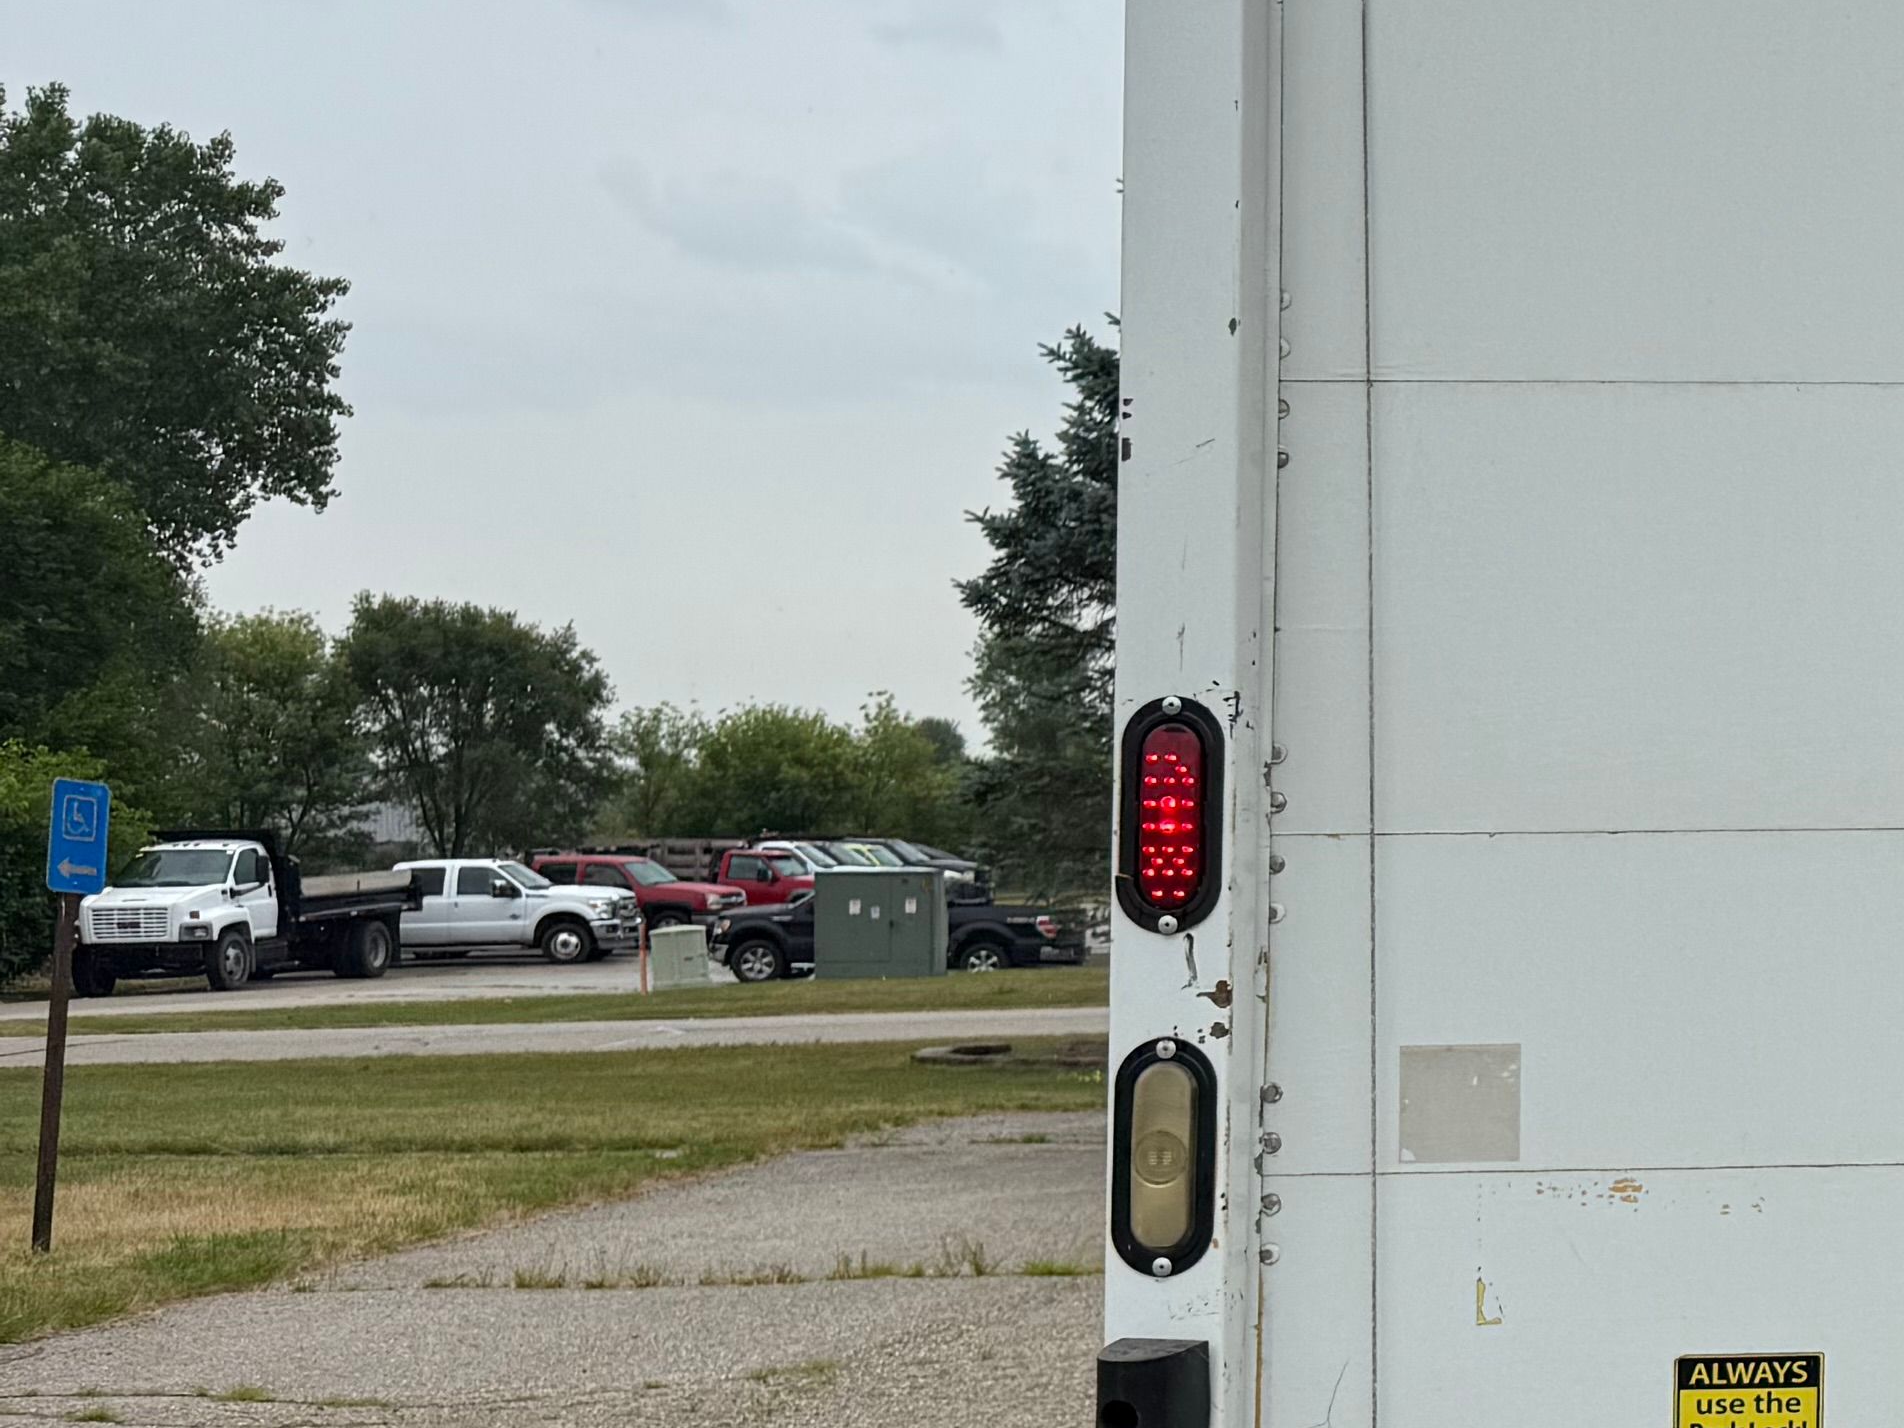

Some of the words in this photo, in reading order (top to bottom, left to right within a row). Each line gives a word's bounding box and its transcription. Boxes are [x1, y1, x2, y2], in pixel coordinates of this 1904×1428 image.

[1689, 1360, 1808, 1385] ALWAYS
[1696, 1397, 1745, 1415] use
[1754, 1390, 1801, 1414] the
